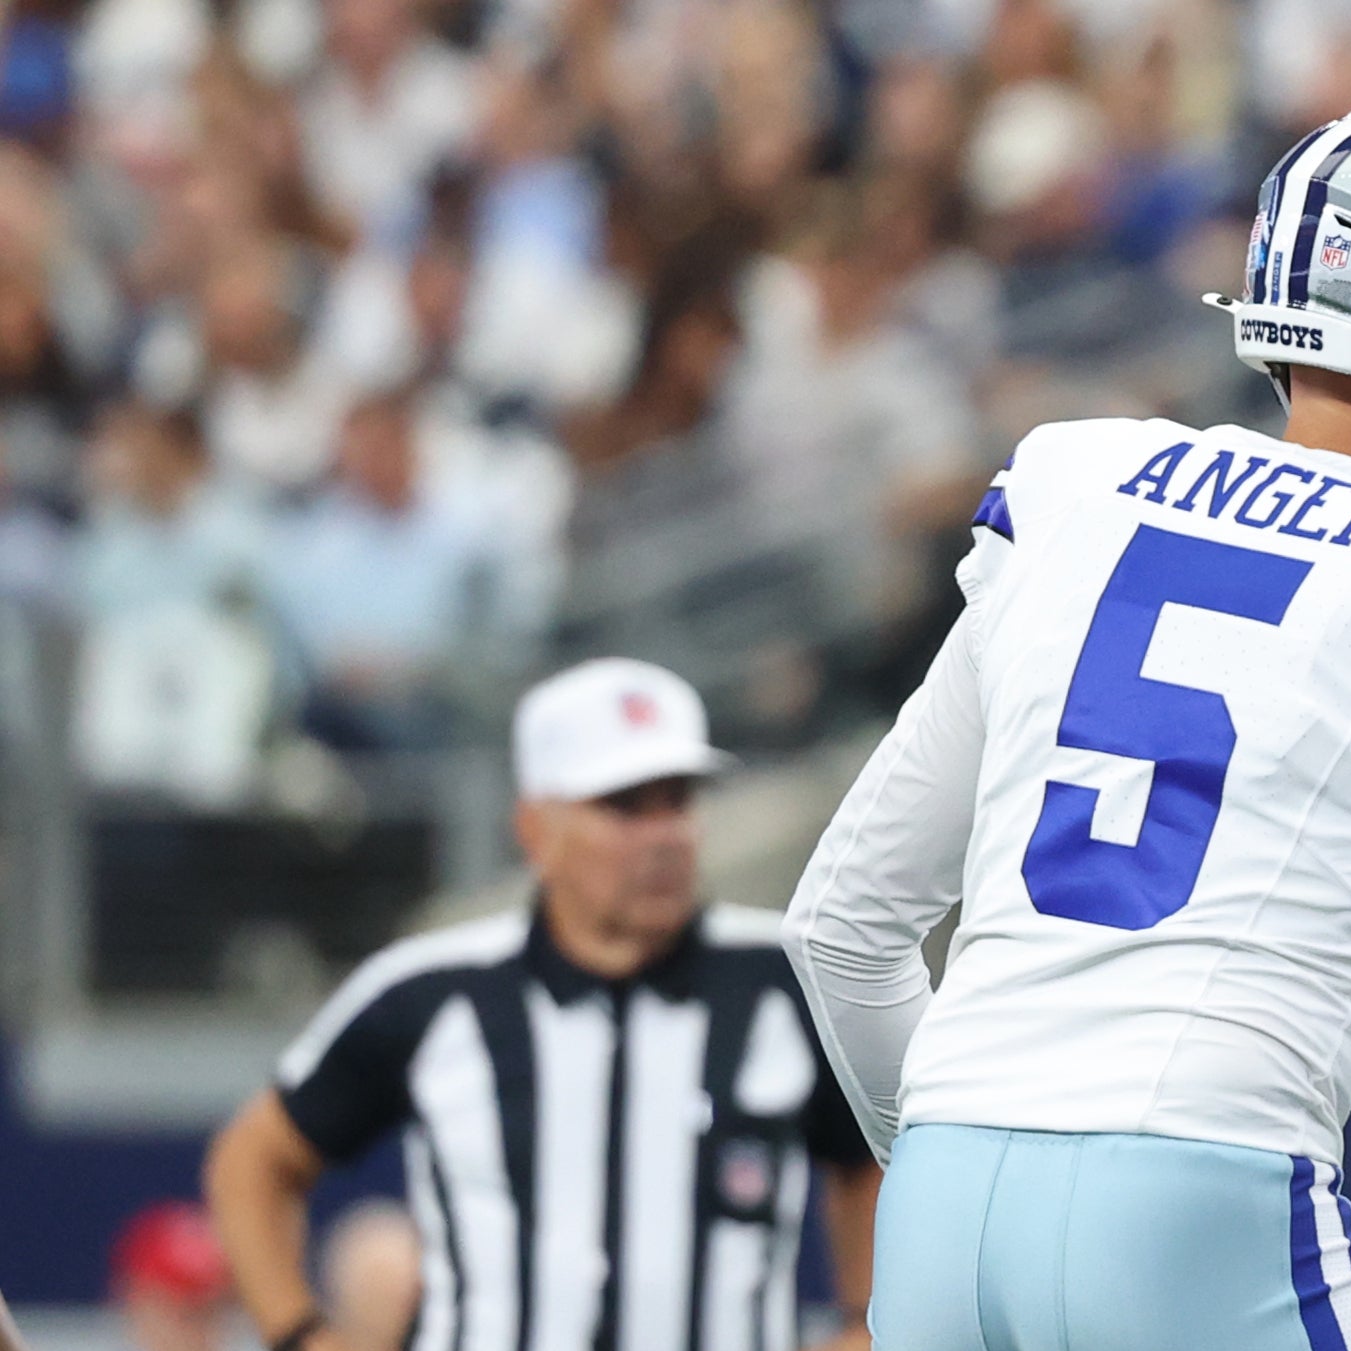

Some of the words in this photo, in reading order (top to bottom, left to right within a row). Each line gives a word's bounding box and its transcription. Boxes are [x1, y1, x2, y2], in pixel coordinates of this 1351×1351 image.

[1322, 249, 1346, 266] NFL
[1241, 319, 1323, 351] COWBOYS
[1020, 522, 1316, 931] 5
